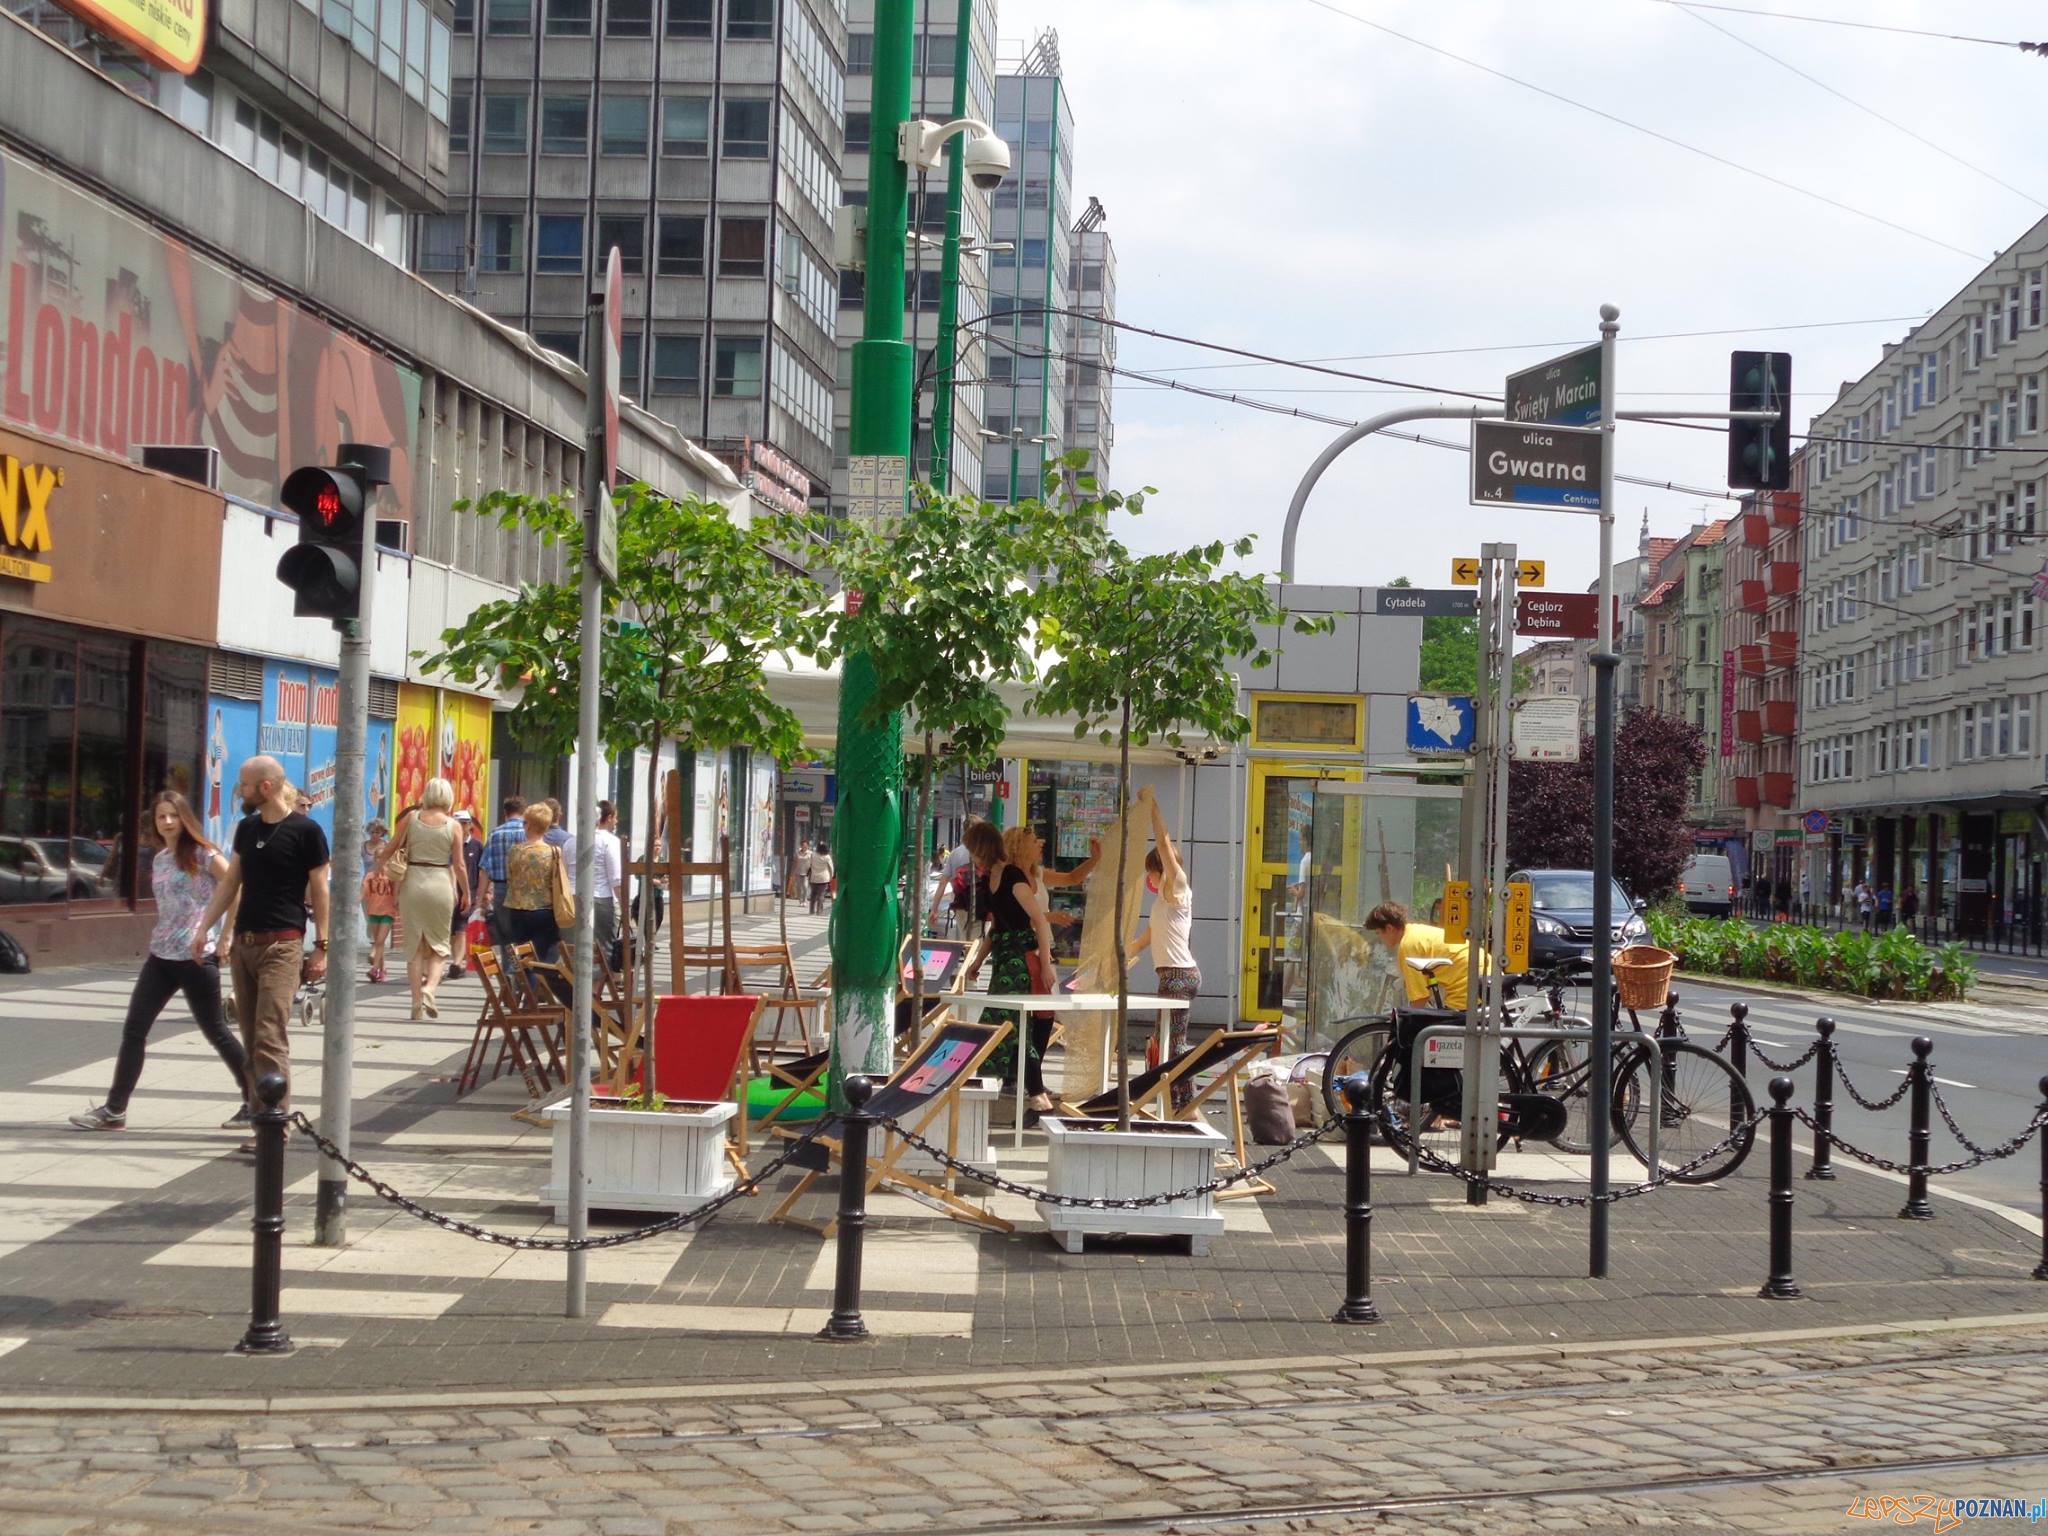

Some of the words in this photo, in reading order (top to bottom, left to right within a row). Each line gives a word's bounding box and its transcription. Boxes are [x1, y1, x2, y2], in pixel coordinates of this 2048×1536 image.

[4, 261, 189, 458] London
[1514, 391, 1549, 422] Święty
[1555, 376, 1597, 409] Marcin
[1523, 432, 1553, 446] ulica
[1488, 450, 1587, 482] Gwarna
[1563, 493, 1601, 505] Centrum
[1385, 597, 1427, 610] Cytadela
[1527, 600, 1564, 614] Ceglorz
[1527, 616, 1561, 629] Dębina
[277, 671, 307, 724] from
[310, 674, 340, 727] Lond
[260, 726, 287, 752] SECOND
[287, 728, 305, 754] HAND
[970, 770, 1002, 783] bilety
[1437, 1041, 1463, 1053] gazeta
